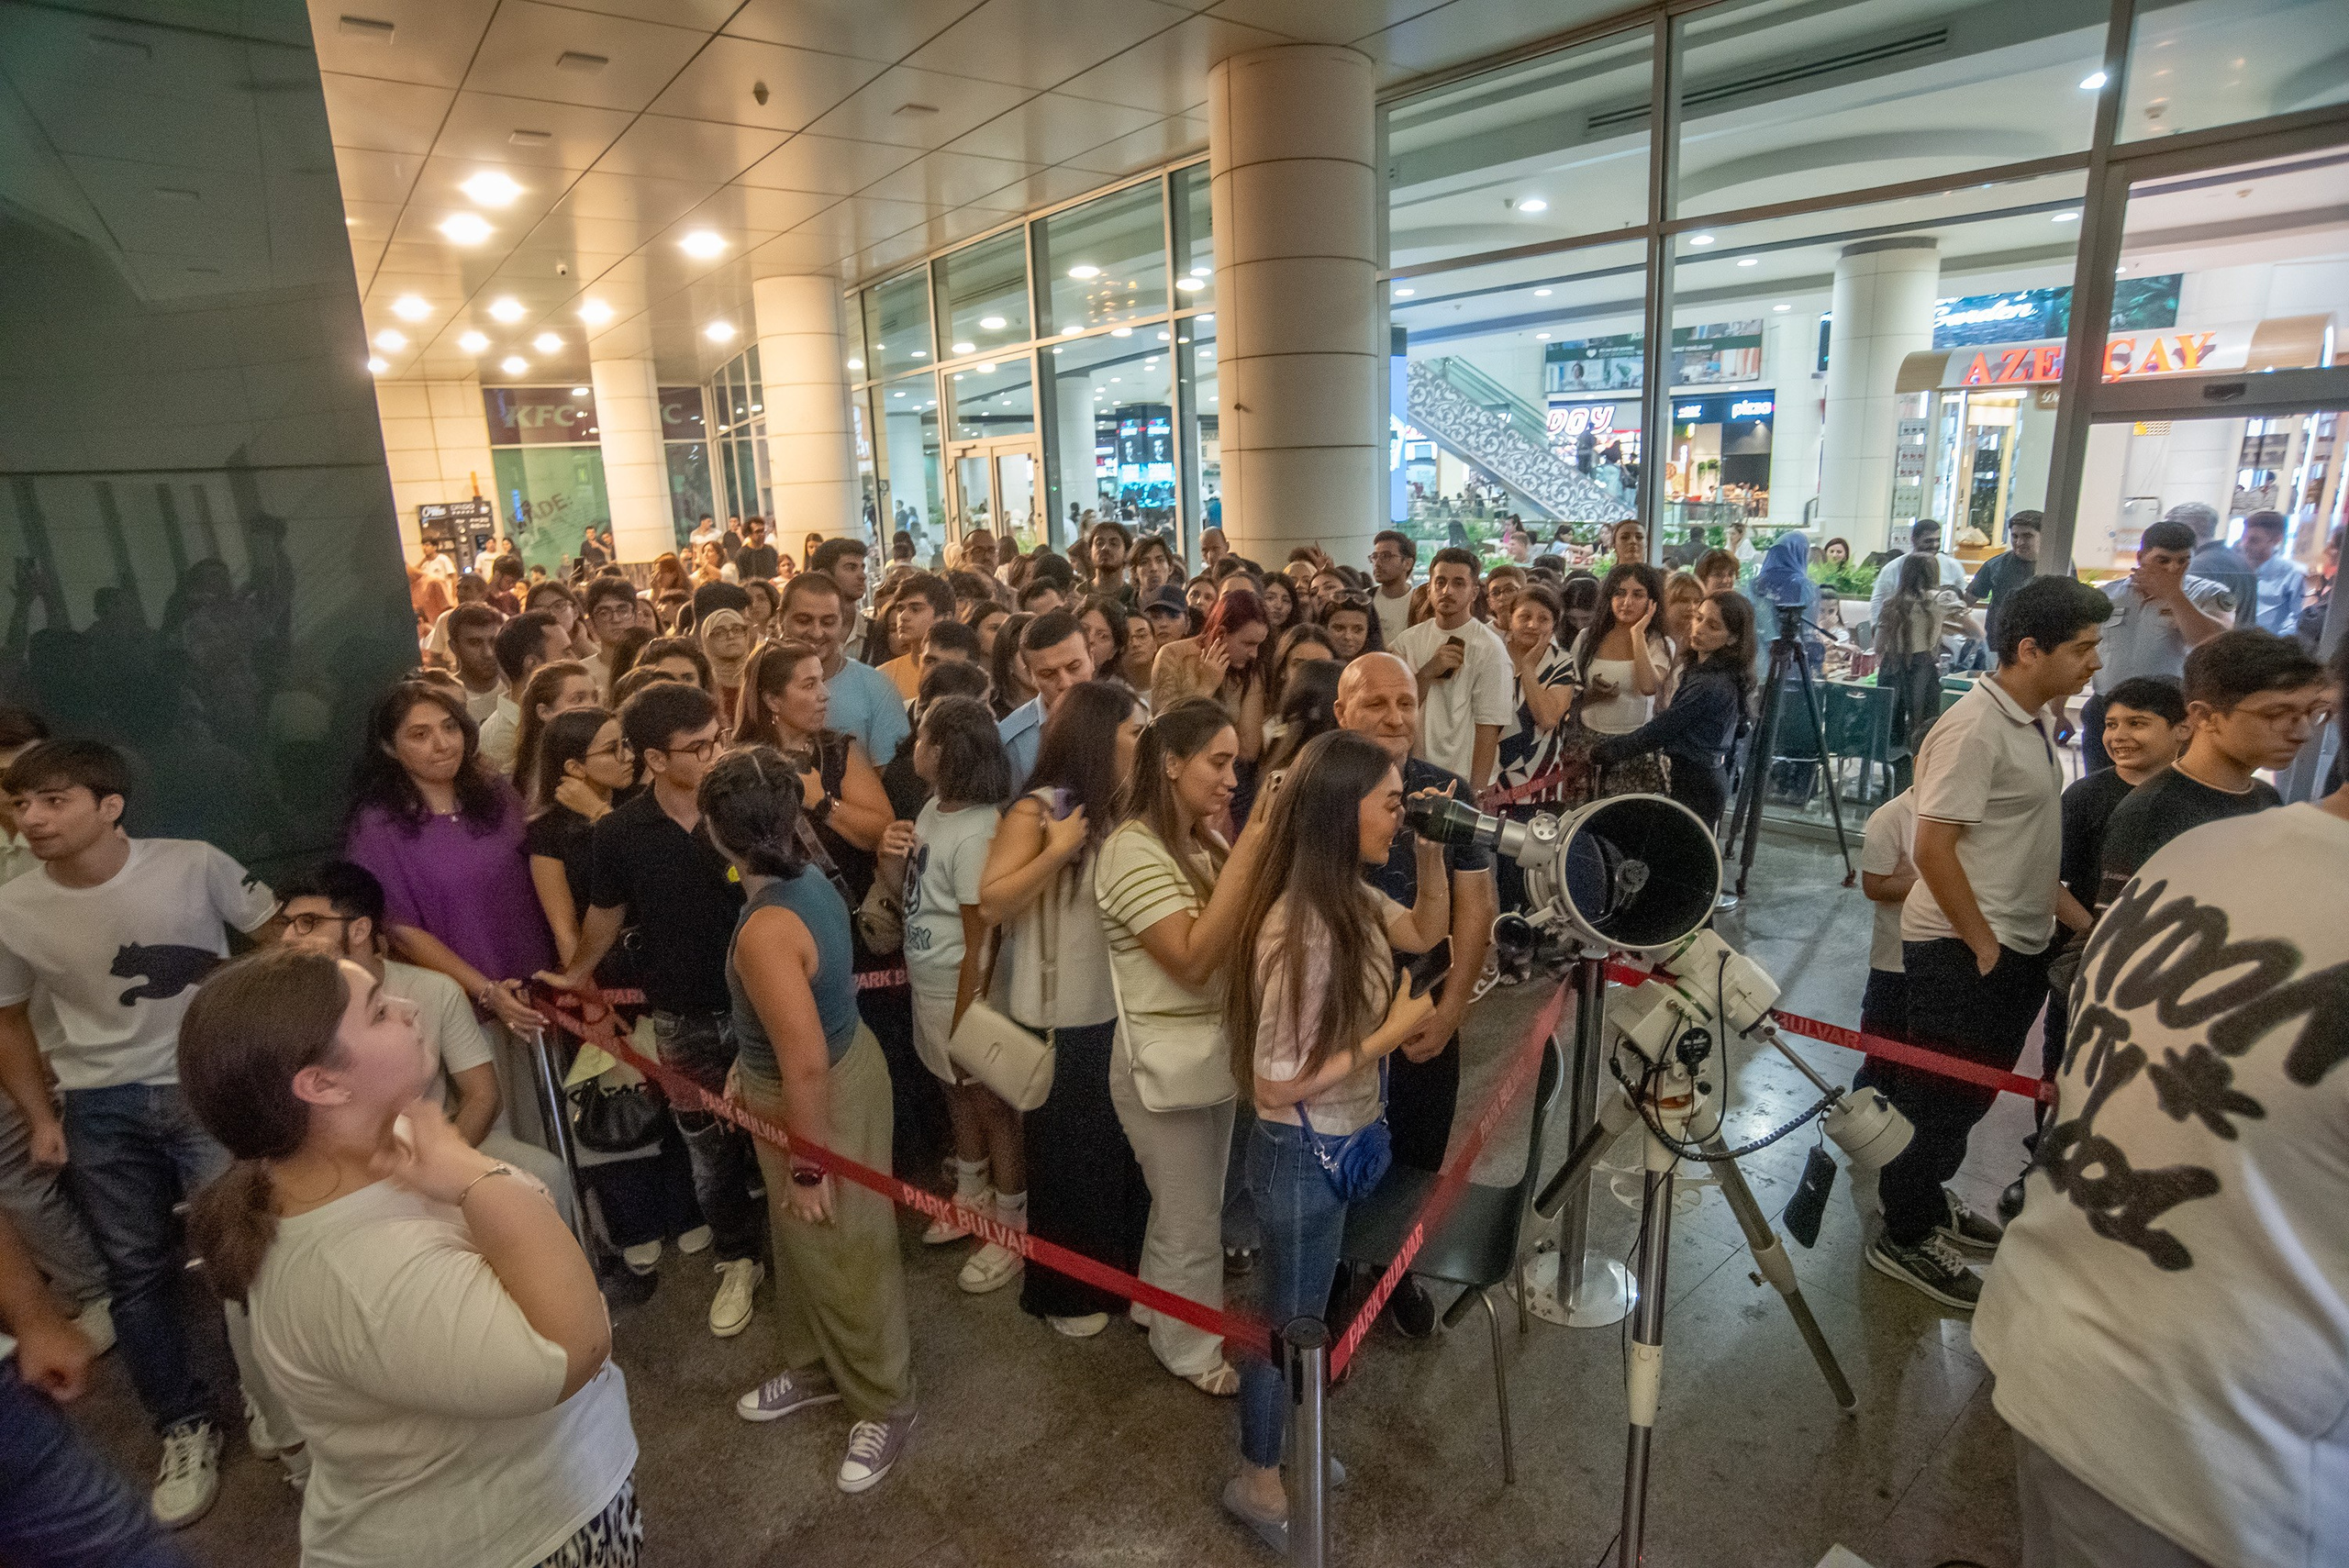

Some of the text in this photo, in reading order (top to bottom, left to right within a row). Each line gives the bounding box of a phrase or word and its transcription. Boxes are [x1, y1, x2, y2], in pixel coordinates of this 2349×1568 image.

[1962, 331, 2216, 385] AZEÇAY
[504, 405, 575, 428] KFC
[902, 1183, 1035, 1258] PARK BULVAR
[1349, 1222, 1424, 1353] PARK BULVAR
